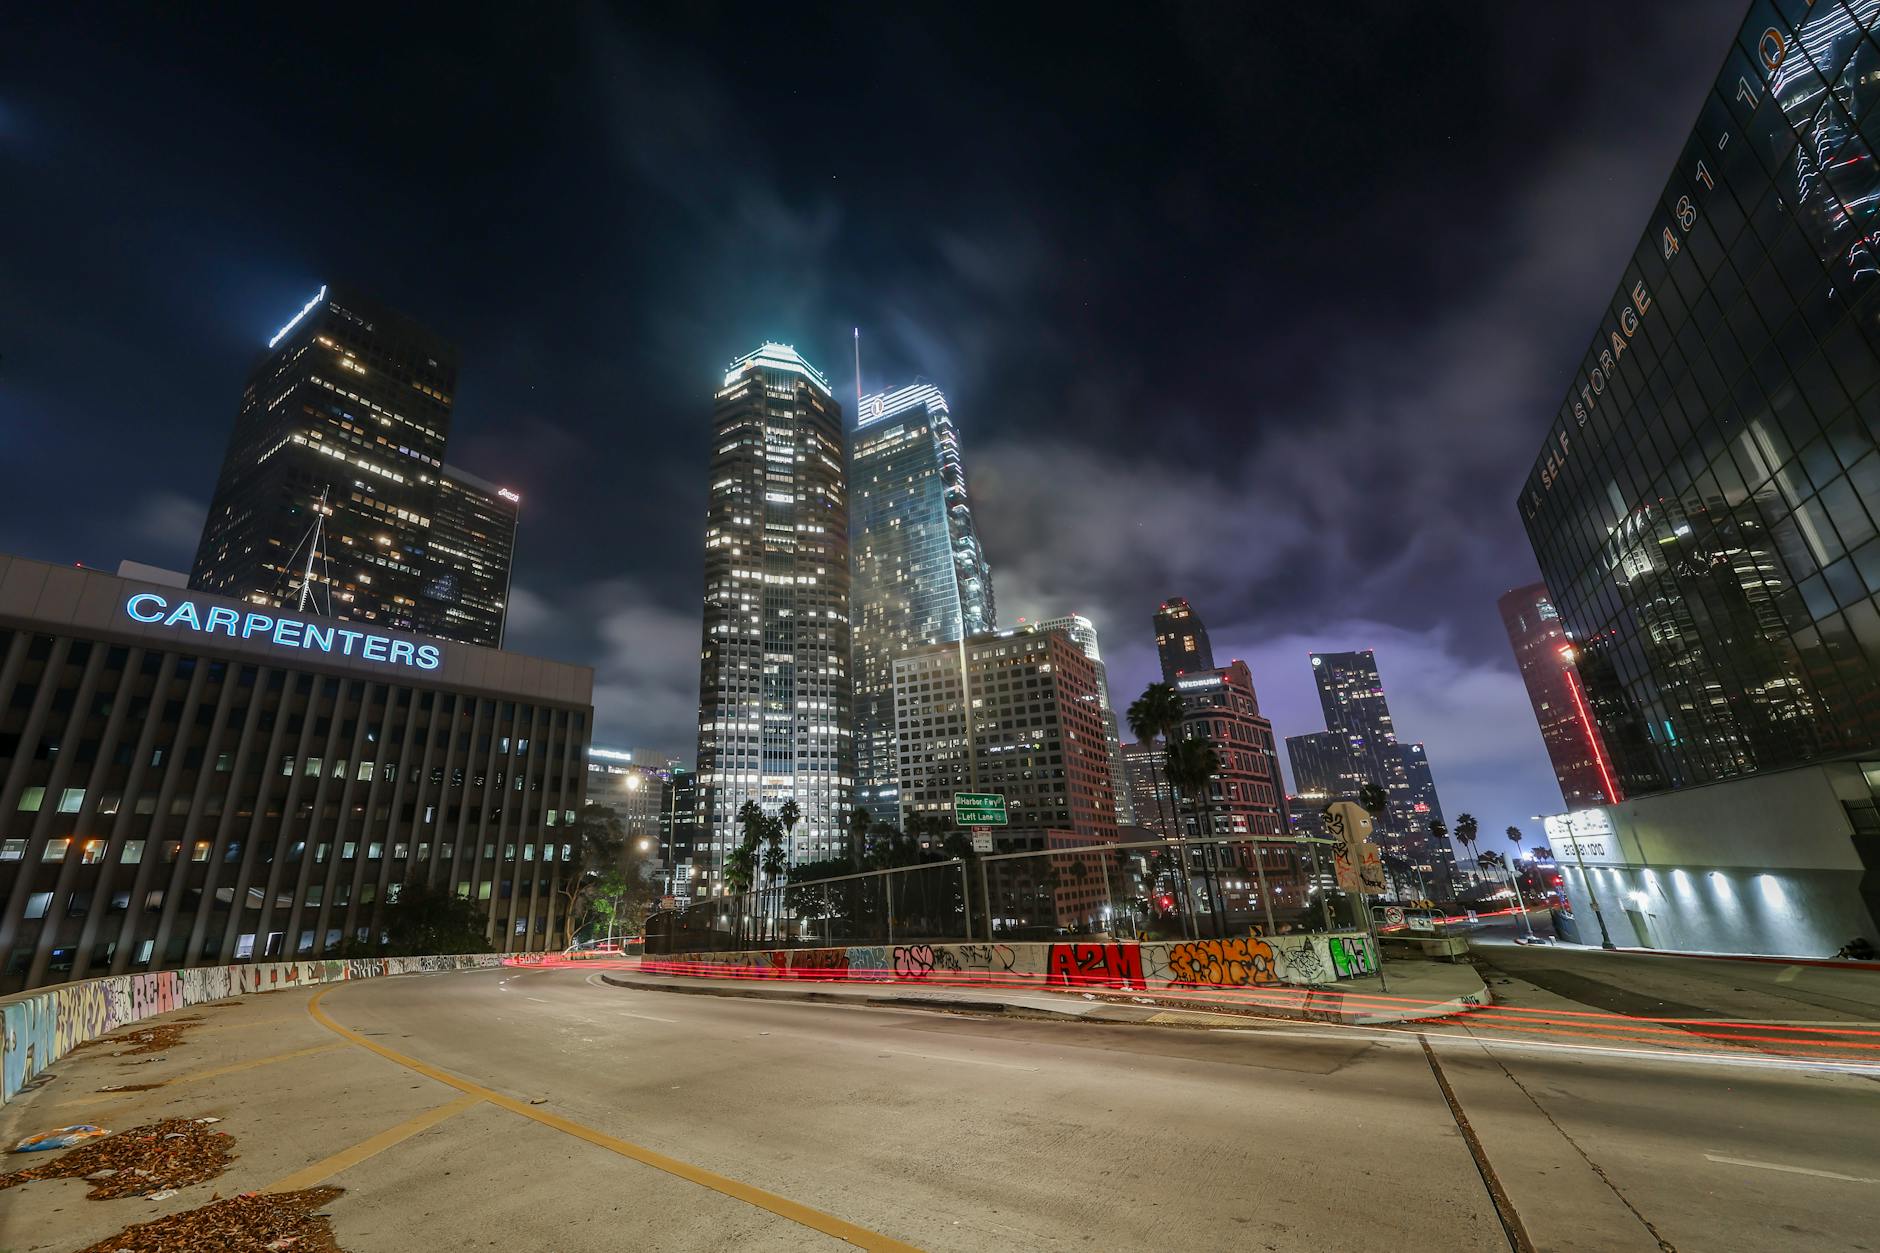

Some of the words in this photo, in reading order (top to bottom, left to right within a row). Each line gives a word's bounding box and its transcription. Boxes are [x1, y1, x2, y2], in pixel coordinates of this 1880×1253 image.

[1541, 430, 1571, 491] SELF
[1573, 280, 1652, 428] STORAGE
[1661, 0, 1817, 260] 481-10
[125, 592, 441, 671] CARPENTERS
[1178, 677, 1221, 689] WEDBUSH
[960, 797, 983, 805] Harbor
[984, 798, 999, 807] Fwy
[1046, 944, 1146, 990] A2M
[132, 971, 184, 1022] REAL
